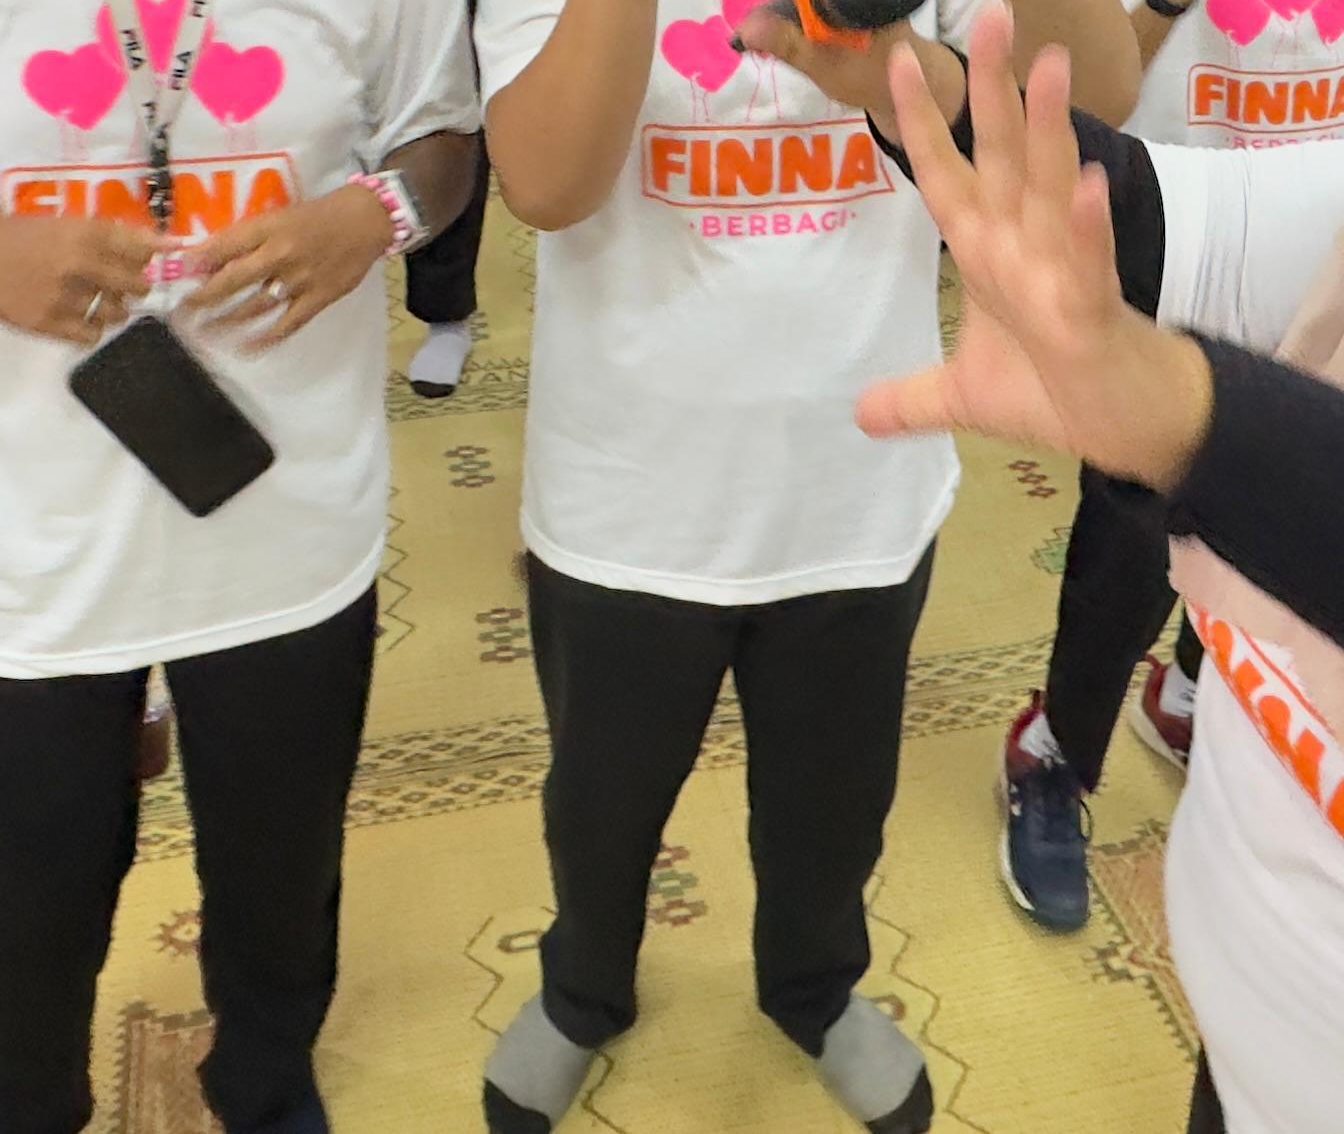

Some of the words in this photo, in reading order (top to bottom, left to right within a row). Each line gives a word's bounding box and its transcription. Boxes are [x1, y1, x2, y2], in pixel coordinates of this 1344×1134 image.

[121, 29, 145, 70] FILA
[169, 50, 192, 90] FILA
[651, 132, 878, 197] FINNA
